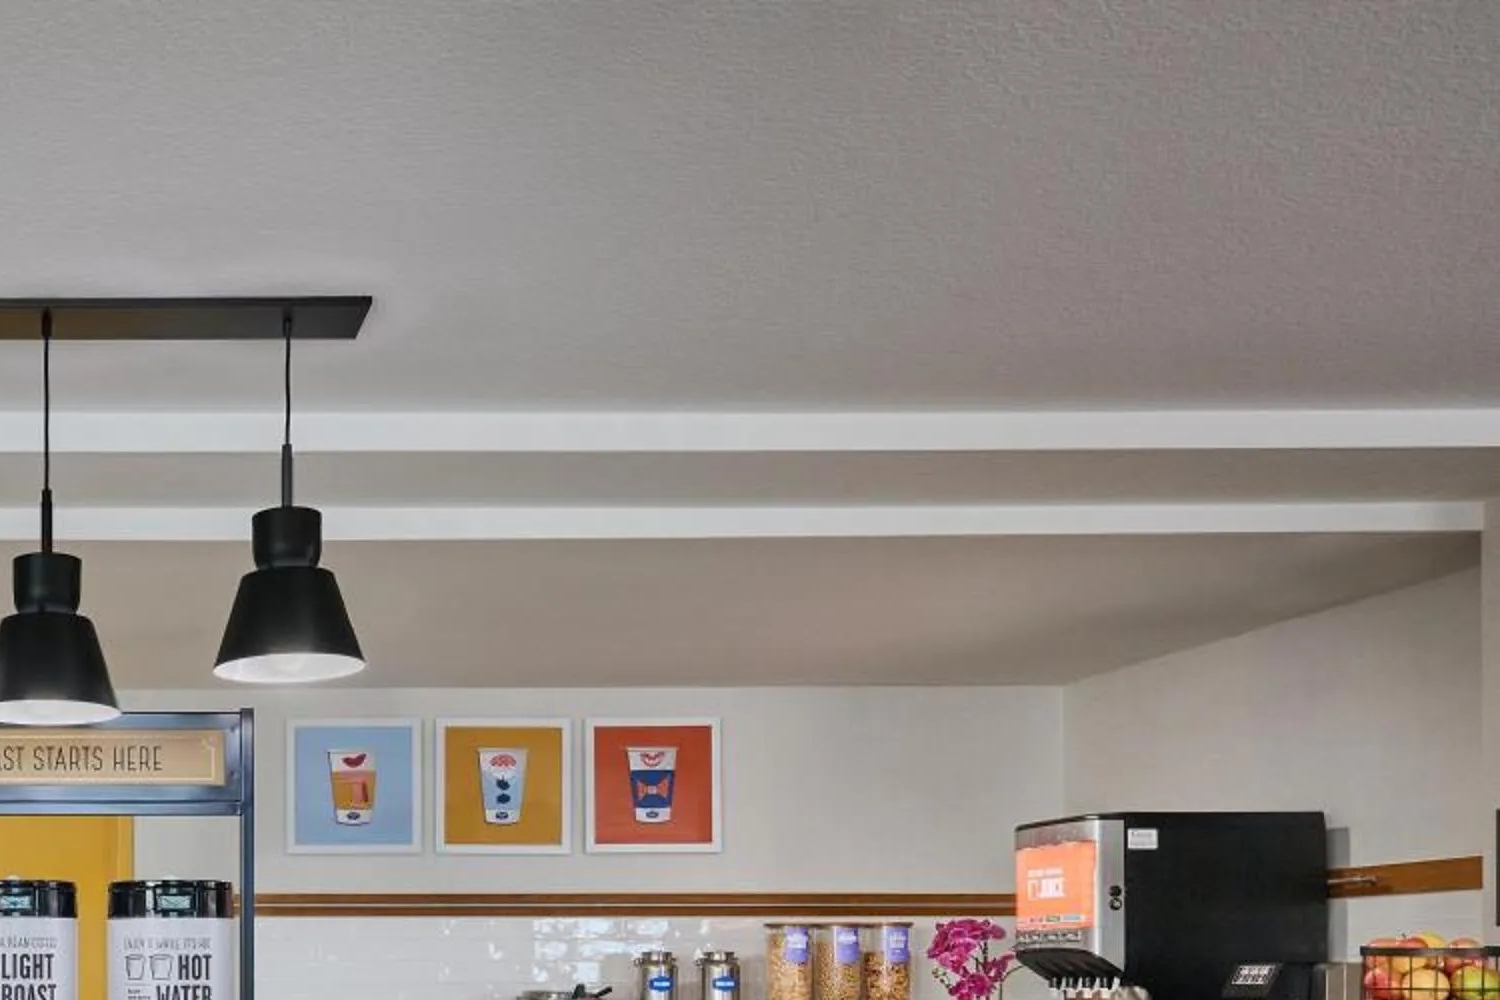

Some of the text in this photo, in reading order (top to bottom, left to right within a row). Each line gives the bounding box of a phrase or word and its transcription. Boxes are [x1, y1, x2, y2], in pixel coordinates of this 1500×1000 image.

[33, 746, 103, 772] STARTS
[113, 746, 163, 772] HERE
[1, 953, 55, 979] LIGHT
[178, 954, 212, 981] HOT
